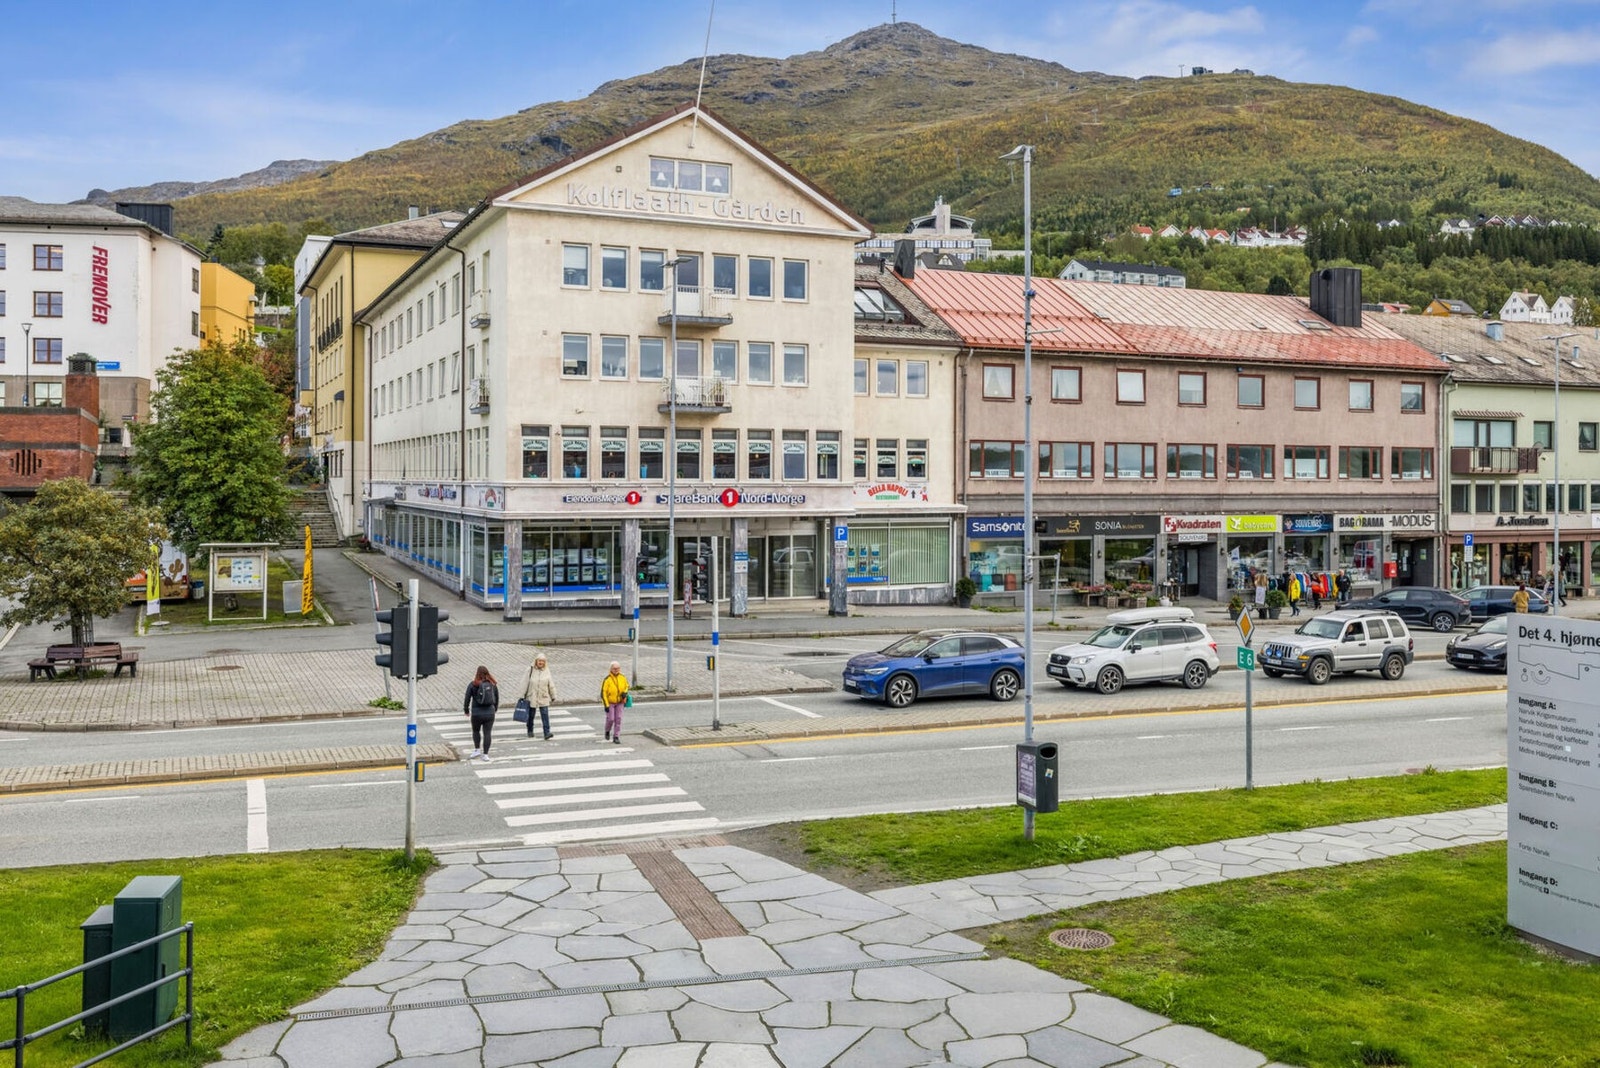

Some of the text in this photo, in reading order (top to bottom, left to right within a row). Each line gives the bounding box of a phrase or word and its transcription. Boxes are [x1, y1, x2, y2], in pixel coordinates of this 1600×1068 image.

[92, 245, 112, 325] FREMOVER
[867, 483, 909, 497] BELLA NAPOLI
[740, 492, 804, 506] Nord-Norge
[1095, 521, 1121, 530] SONIA
[1176, 519, 1221, 529] Kvadraten
[837, 528, 845, 540] P
[1518, 625, 1540, 640] Det
[1543, 628, 1556, 642] 4.
[1518, 696, 1557, 710] Inngang A:
[1518, 772, 1557, 789] Inngang B:
[1518, 812, 1559, 830] Inngang C:
[1518, 867, 1559, 887] Inngang D:
